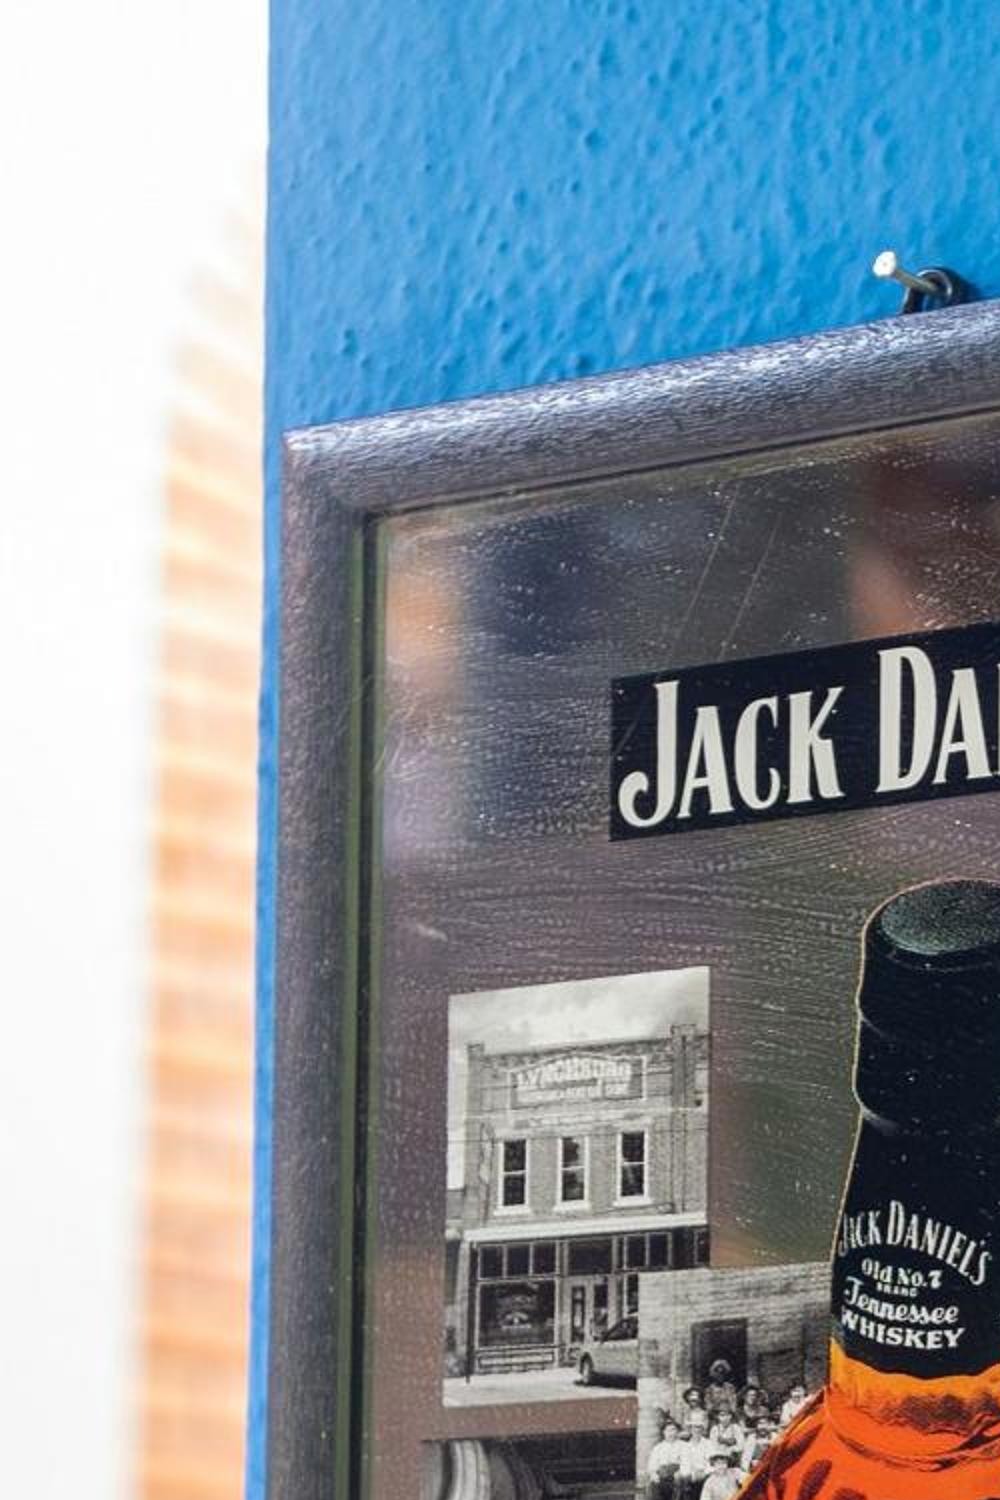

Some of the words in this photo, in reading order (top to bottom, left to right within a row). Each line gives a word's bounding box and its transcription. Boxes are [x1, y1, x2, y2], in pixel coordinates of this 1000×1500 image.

[618, 680, 844, 830] JACK
[838, 1210, 881, 1257] JACK
[886, 1199, 993, 1286] DANIEL'S
[861, 1258, 894, 1284] Old
[844, 1275, 959, 1324] Tennessee
[841, 1305, 965, 1350] WHISKEY
